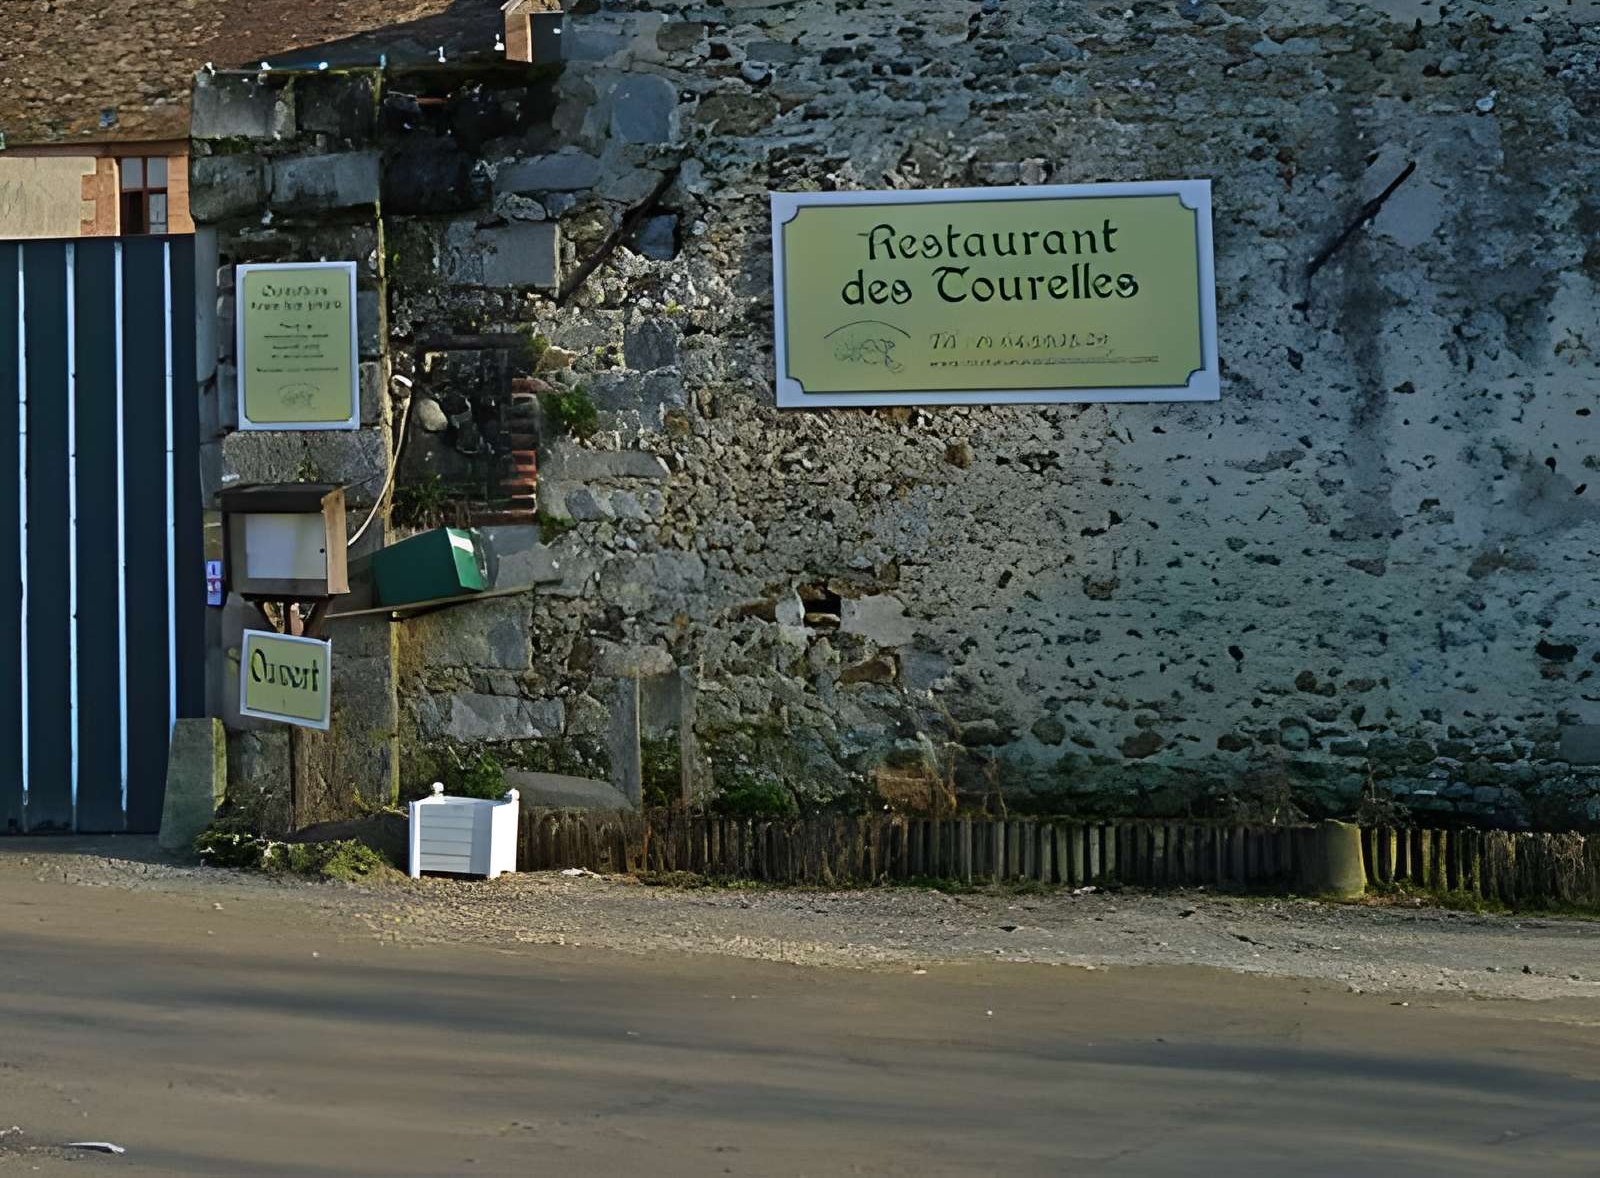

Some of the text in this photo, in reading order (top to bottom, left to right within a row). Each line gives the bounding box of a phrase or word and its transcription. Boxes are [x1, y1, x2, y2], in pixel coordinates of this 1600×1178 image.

[858, 219, 1119, 260] Restaurant
[841, 262, 1140, 305] des Tourelles
